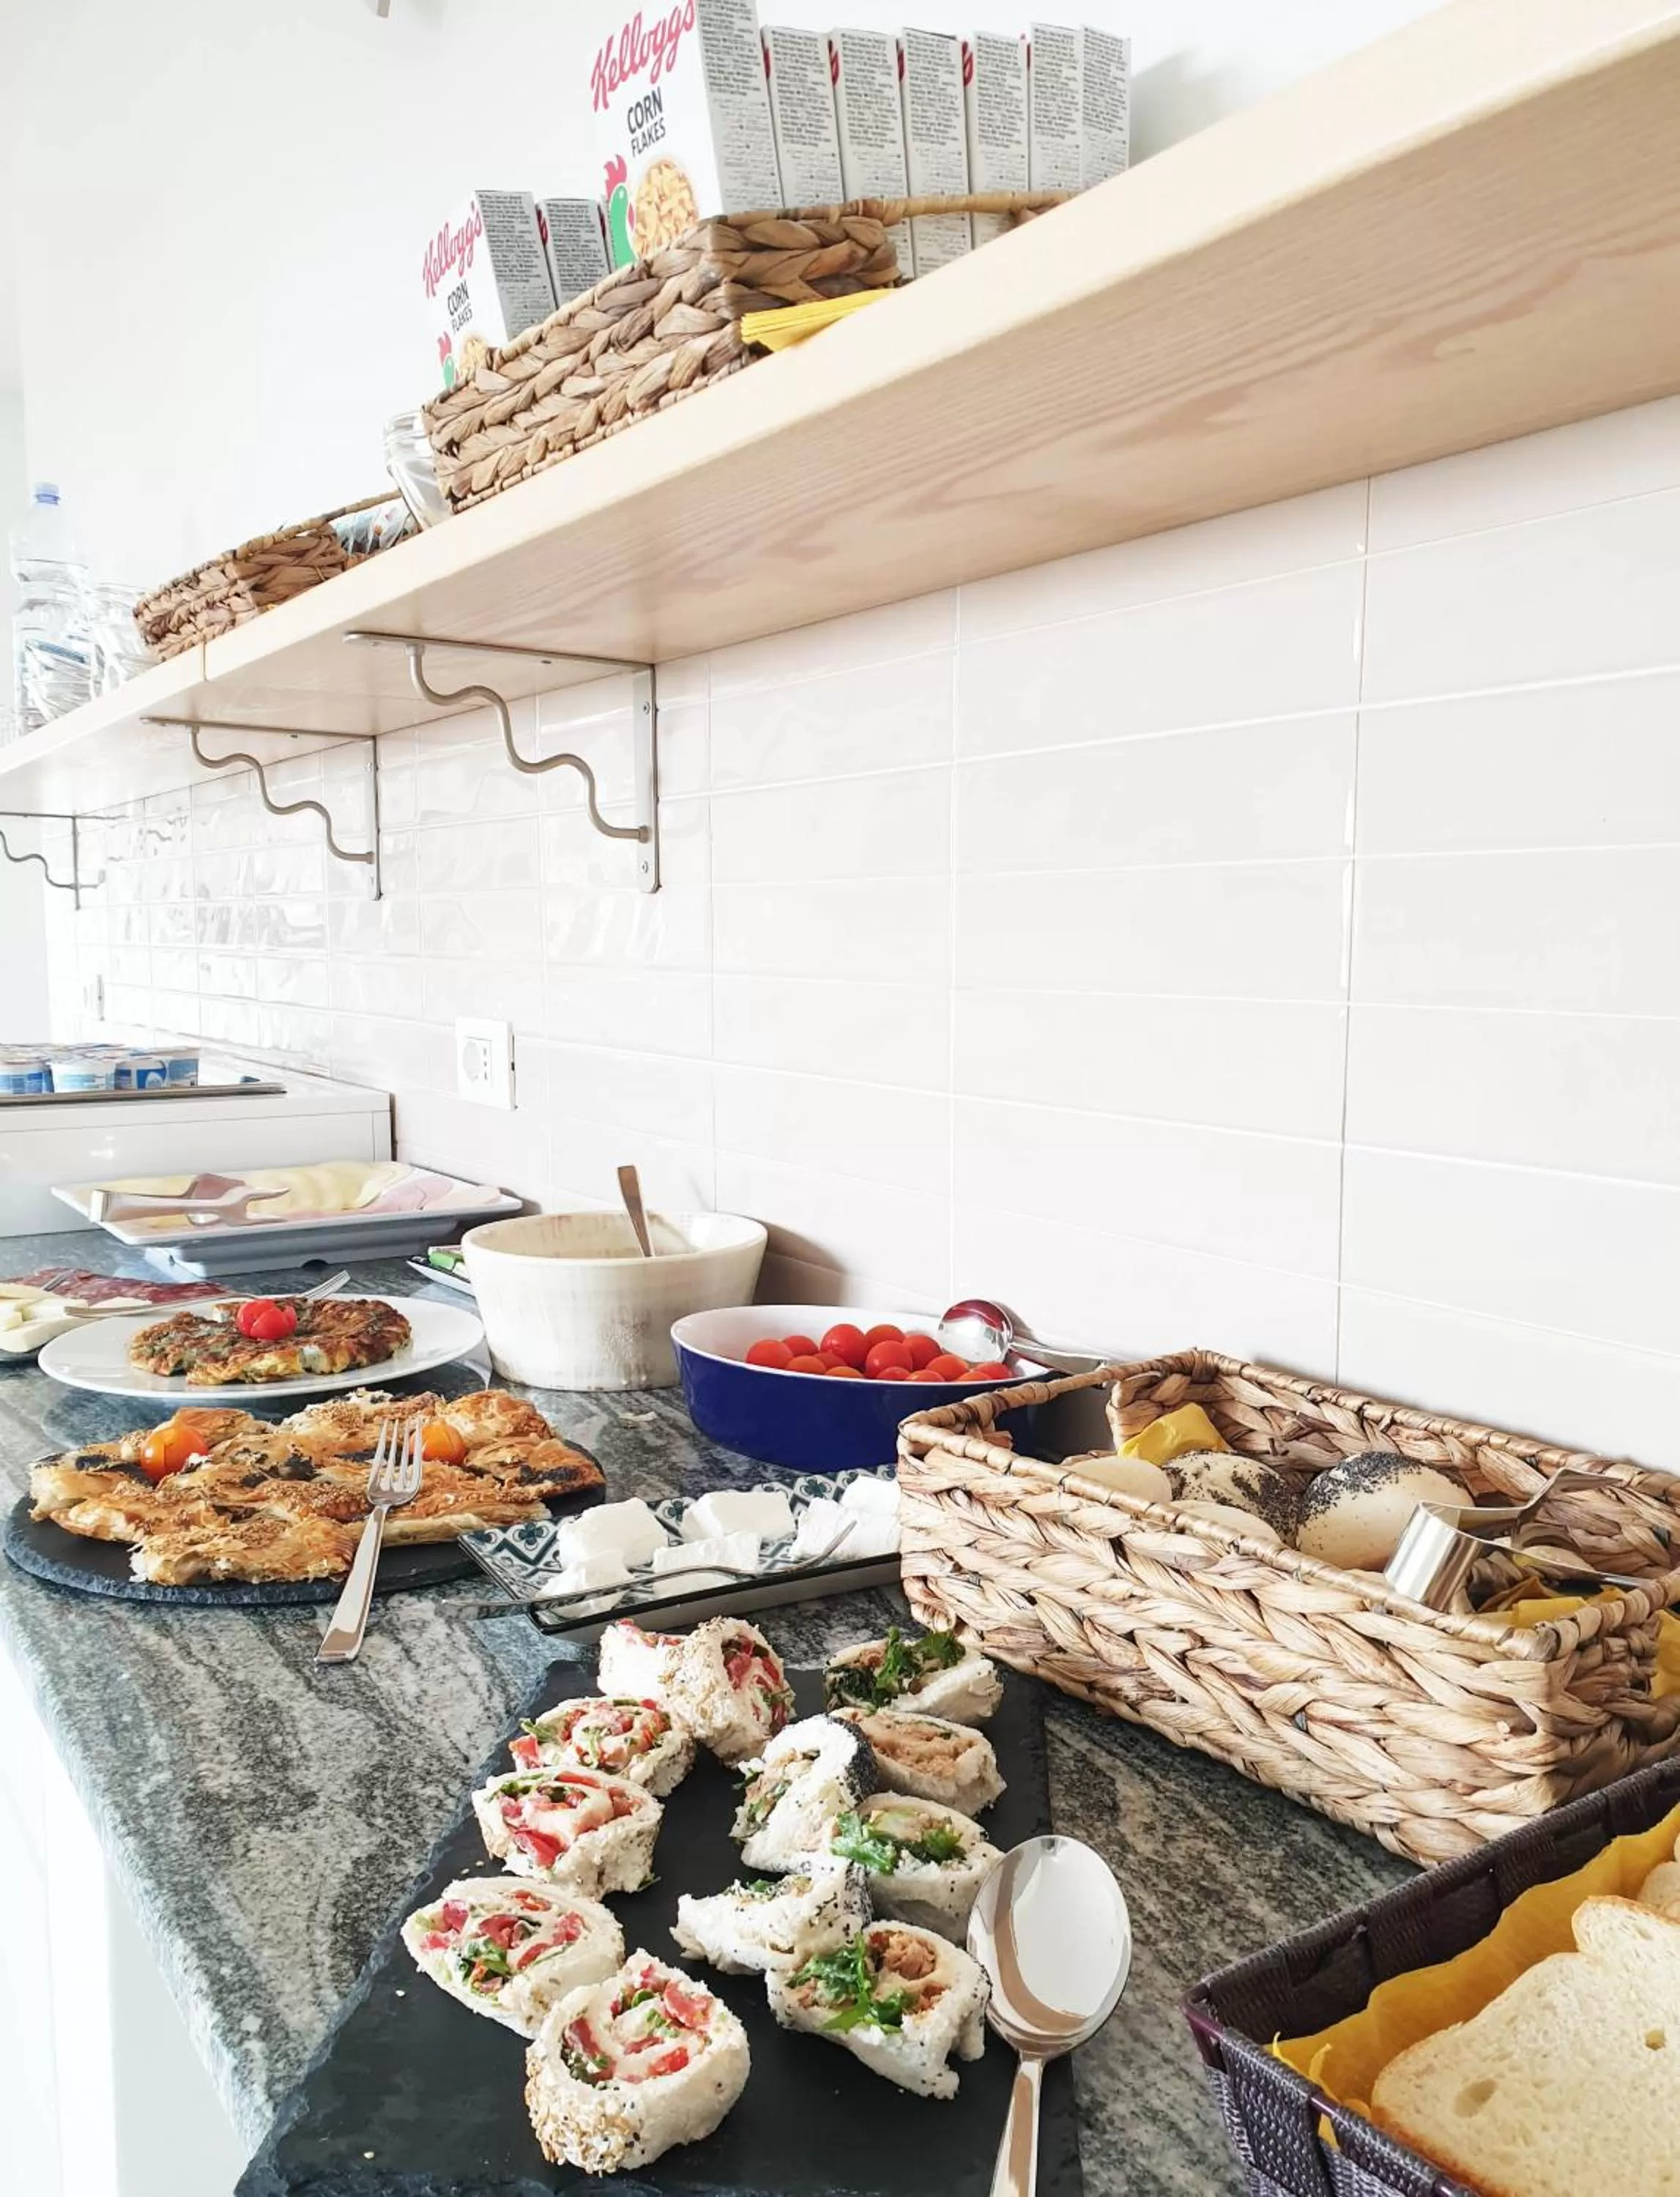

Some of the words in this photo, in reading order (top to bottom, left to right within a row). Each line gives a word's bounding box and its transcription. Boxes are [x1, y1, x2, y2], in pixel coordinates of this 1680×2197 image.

[590, 0, 695, 112] Kelloggs
[627, 86, 663, 135] CORN
[631, 117, 666, 157] FLAKES
[447, 279, 470, 317] CORN
